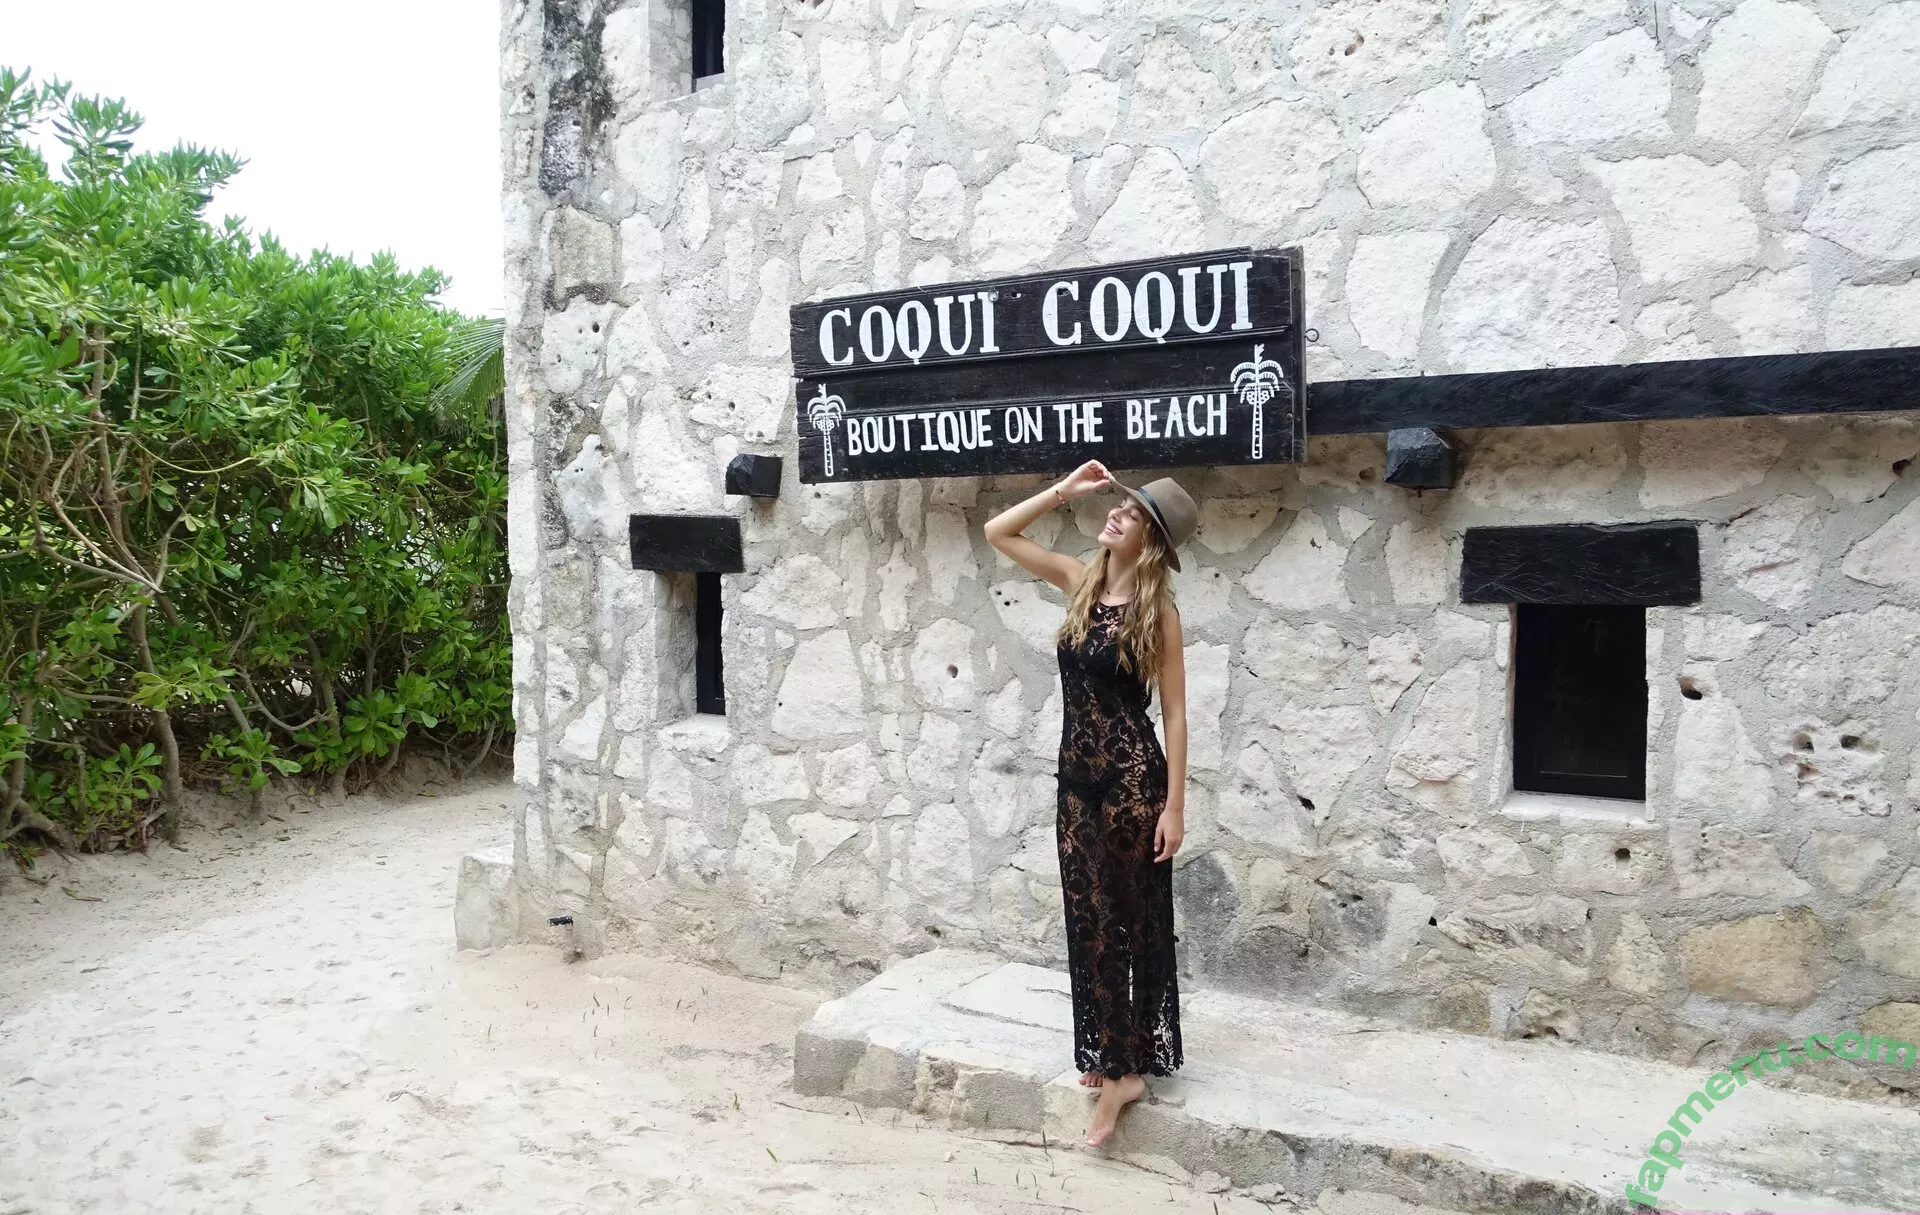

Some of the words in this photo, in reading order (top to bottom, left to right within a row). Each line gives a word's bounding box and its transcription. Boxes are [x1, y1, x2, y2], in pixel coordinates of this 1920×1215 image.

[819, 292, 1000, 365] COQUI
[1042, 261, 1254, 346] COQUI
[848, 408, 993, 456] BOUTIQUE
[1005, 406, 1043, 443] ON
[1053, 401, 1104, 444] THE
[1126, 393, 1228, 440] BEACH
